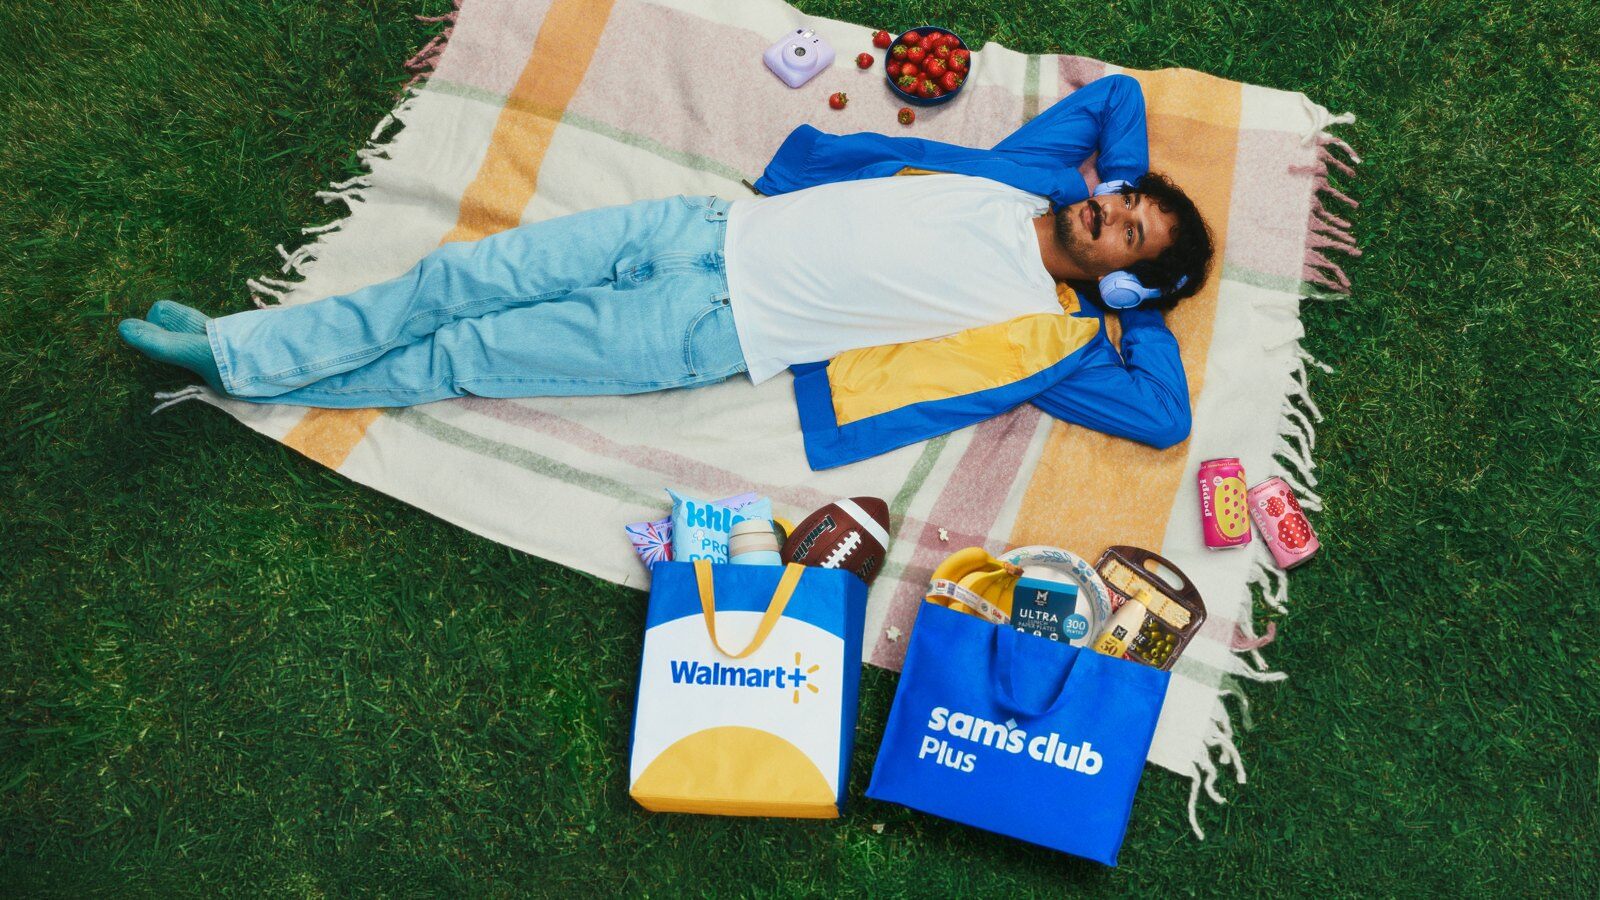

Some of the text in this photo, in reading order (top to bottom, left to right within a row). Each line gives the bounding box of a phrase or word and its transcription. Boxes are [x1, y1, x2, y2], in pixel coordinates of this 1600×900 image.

[1200, 479, 1212, 517] poppi
[791, 514, 837, 562] Franklin
[1020, 608, 1058, 623] ULTRA
[1066, 619, 1086, 631] 300
[1101, 642, 1118, 656] 50
[918, 735, 977, 773] Plus
[1028, 732, 1104, 776] club
